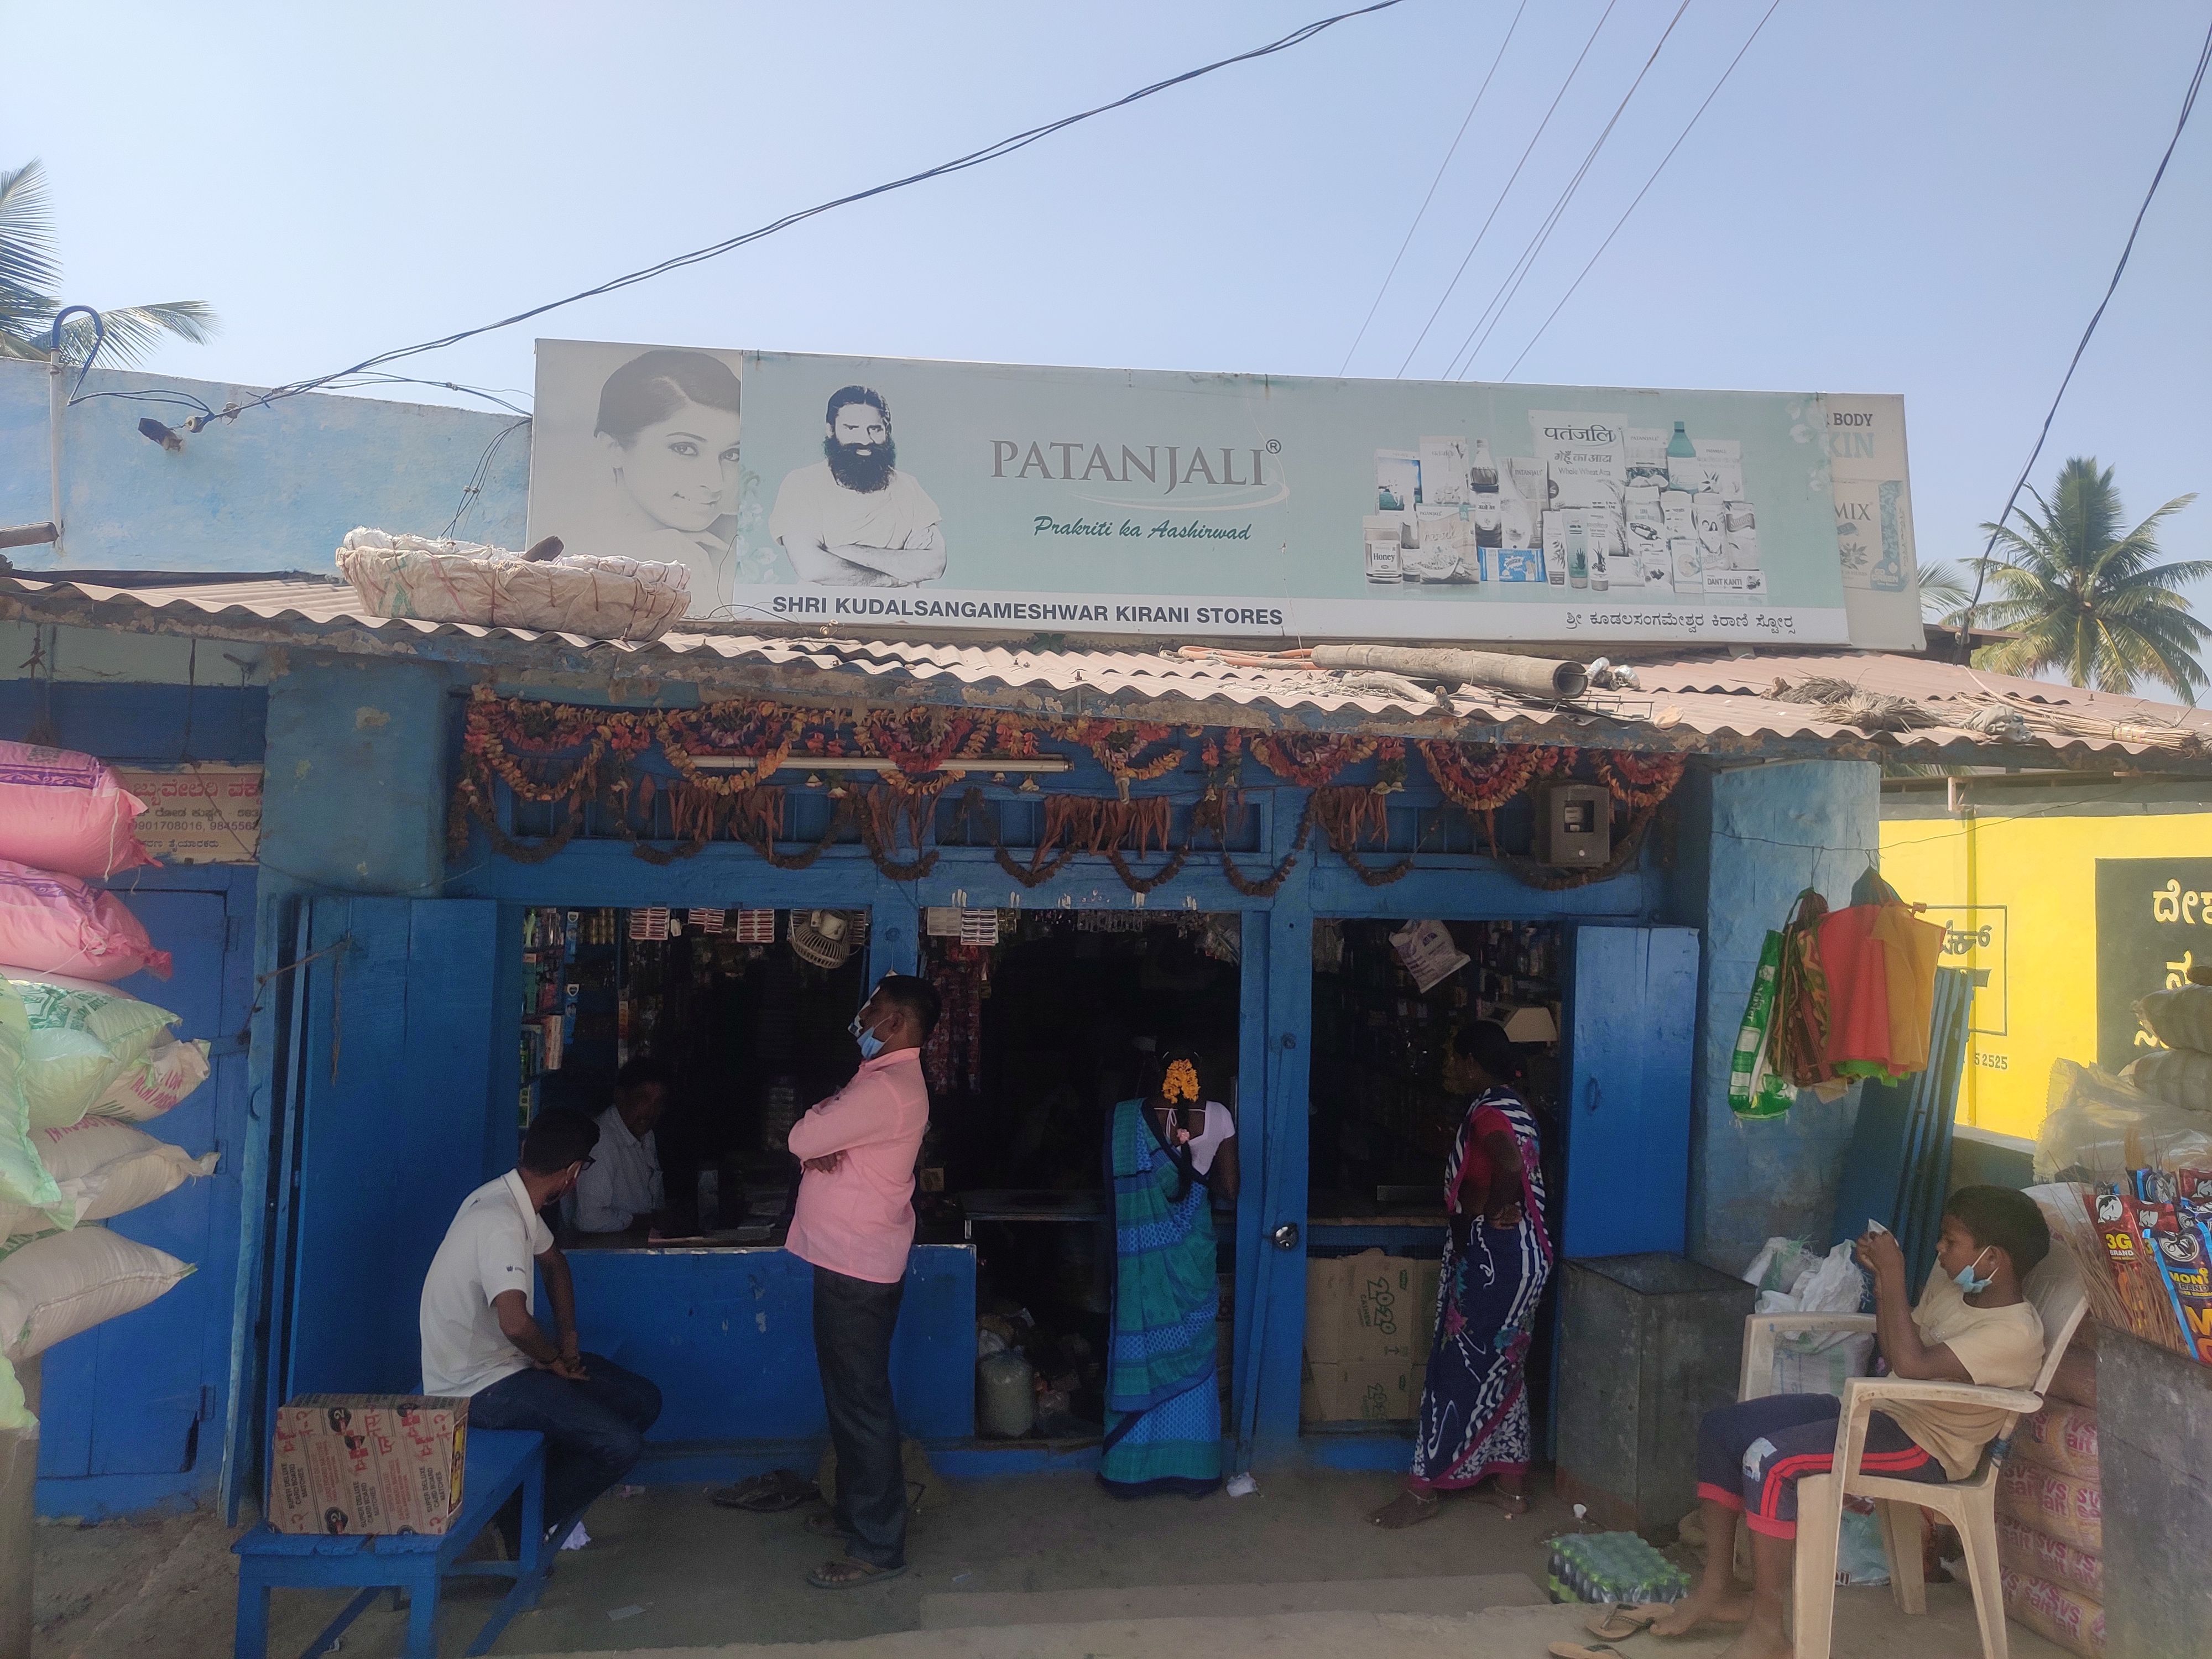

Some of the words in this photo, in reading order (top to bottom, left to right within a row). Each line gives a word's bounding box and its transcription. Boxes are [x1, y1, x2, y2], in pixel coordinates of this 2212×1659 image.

[1833, 413, 1873, 426] BODY
[1543, 425, 1613, 442] पतंजलि
[990, 440, 1267, 495] PATANJALI
[1034, 516, 1113, 537] Prakriti
[1119, 519, 1142, 537] ka
[1147, 520, 1251, 541] Aashirwad
[1373, 553, 1395, 561] Honey
[773, 596, 827, 613] SHRI
[836, 598, 1108, 620] KUDALSANGAMESHWAR
[1116, 606, 1190, 623] KIRANI
[1196, 608, 1282, 625] STORES
[1566, 612, 1582, 629] ಶ್ರೀ
[1712, 613, 1748, 627] ಕಿರಾಣಿ
[2105, 1233, 2133, 1249] 3G
[281, 1463, 290, 1487] DELUXE
[298, 1468, 307, 1498] MATCHES
[419, 1466, 428, 1490] DELUXE
[436, 1472, 445, 1500] MATCHES
[286, 1488, 295, 1509] SUPER
[353, 1481, 362, 1505] DELUXE
[361, 1483, 370, 1504] BOARD
[369, 1486, 379, 1516] MATCHES
[424, 1492, 432, 1512] SUPER
[358, 1506, 367, 1527] SUPER
